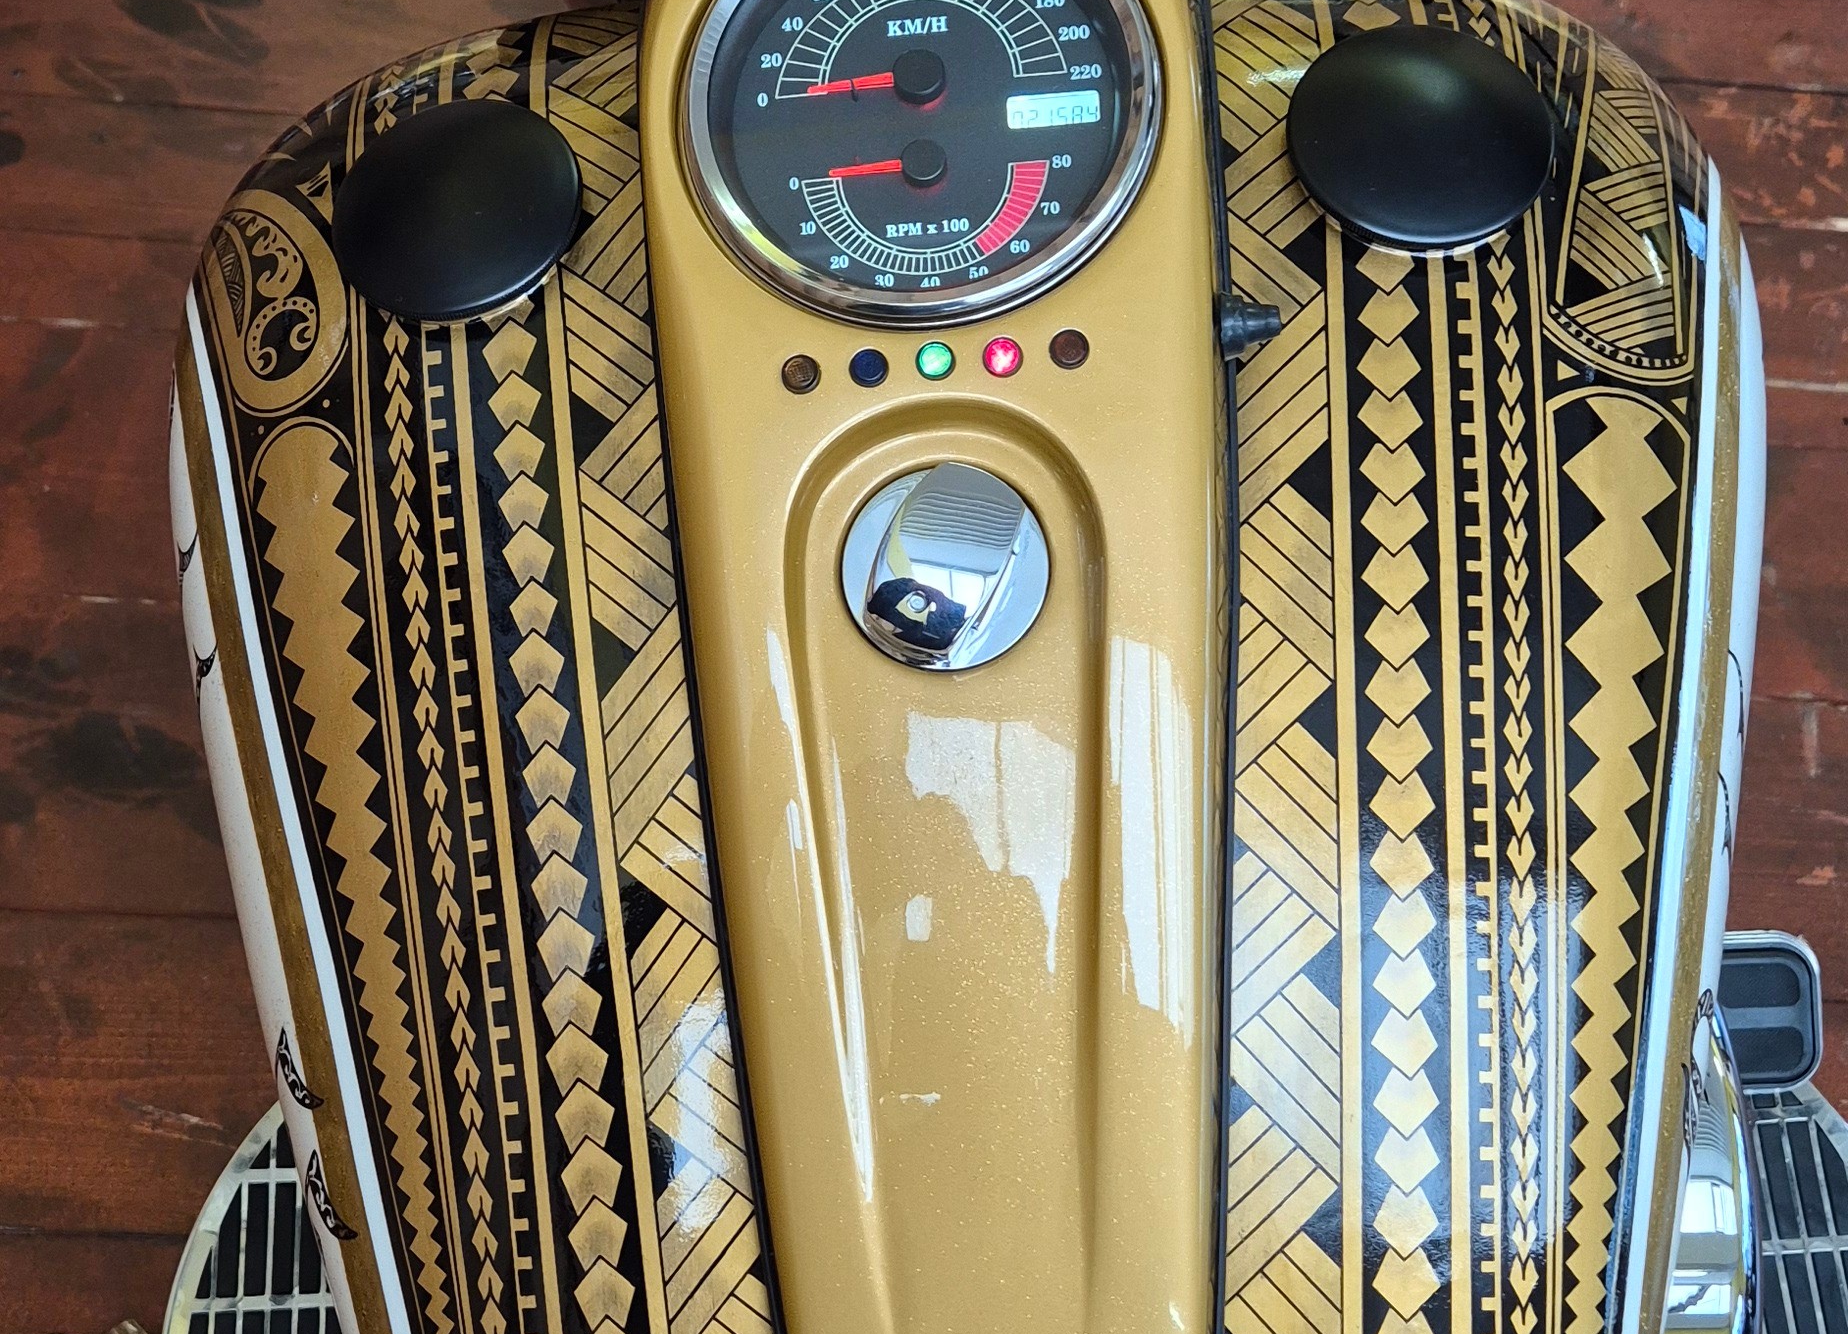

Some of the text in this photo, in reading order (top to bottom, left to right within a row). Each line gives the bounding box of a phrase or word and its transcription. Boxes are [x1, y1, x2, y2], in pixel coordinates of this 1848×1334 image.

[781, 16, 804, 32] 40
[886, 16, 949, 37] KM/H
[1058, 24, 1090, 41] 200
[760, 52, 783, 68] 20
[1069, 63, 1102, 80] 220
[757, 92, 769, 107] 0
[1051, 154, 1072, 168] 80
[789, 177, 799, 191] 0
[1041, 201, 1061, 215] 70
[799, 221, 816, 236] 10
[886, 217, 969, 238] RPM x 100
[1009, 239, 1030, 254] 60
[830, 254, 849, 269] 20
[968, 265, 989, 279] 50
[875, 273, 894, 288] 30
[920, 276, 941, 288] 40
